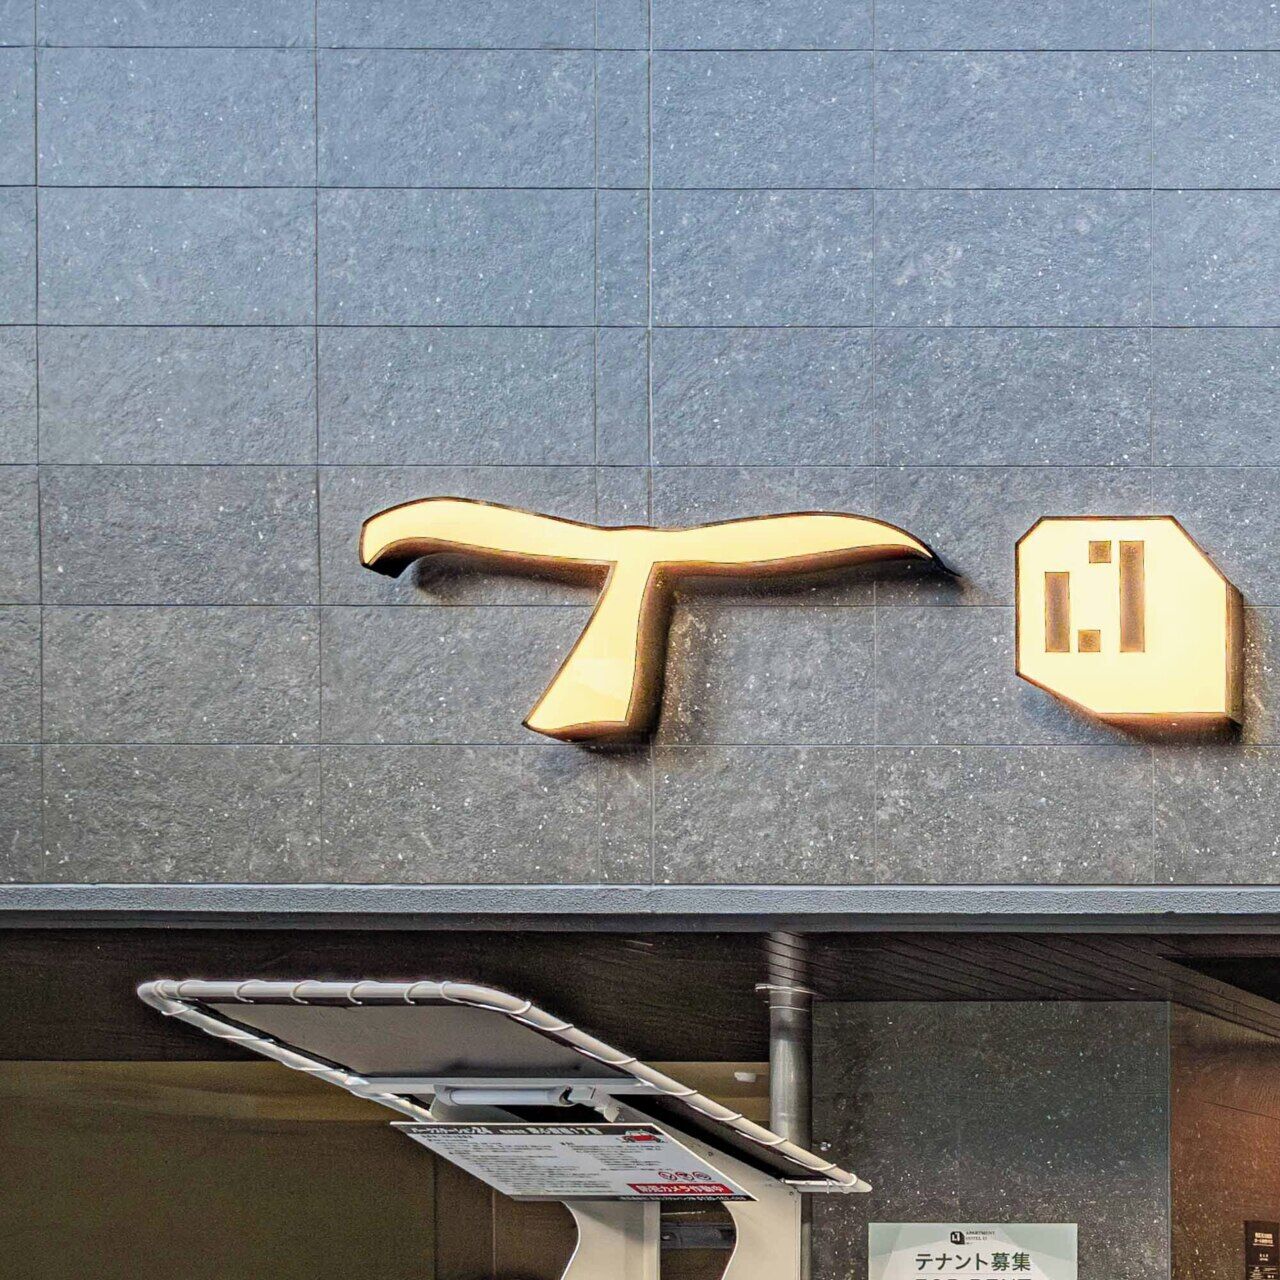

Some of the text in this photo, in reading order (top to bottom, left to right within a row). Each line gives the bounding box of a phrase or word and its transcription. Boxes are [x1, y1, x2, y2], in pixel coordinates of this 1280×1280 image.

[915, 1252, 1031, 1271] テナント募集
